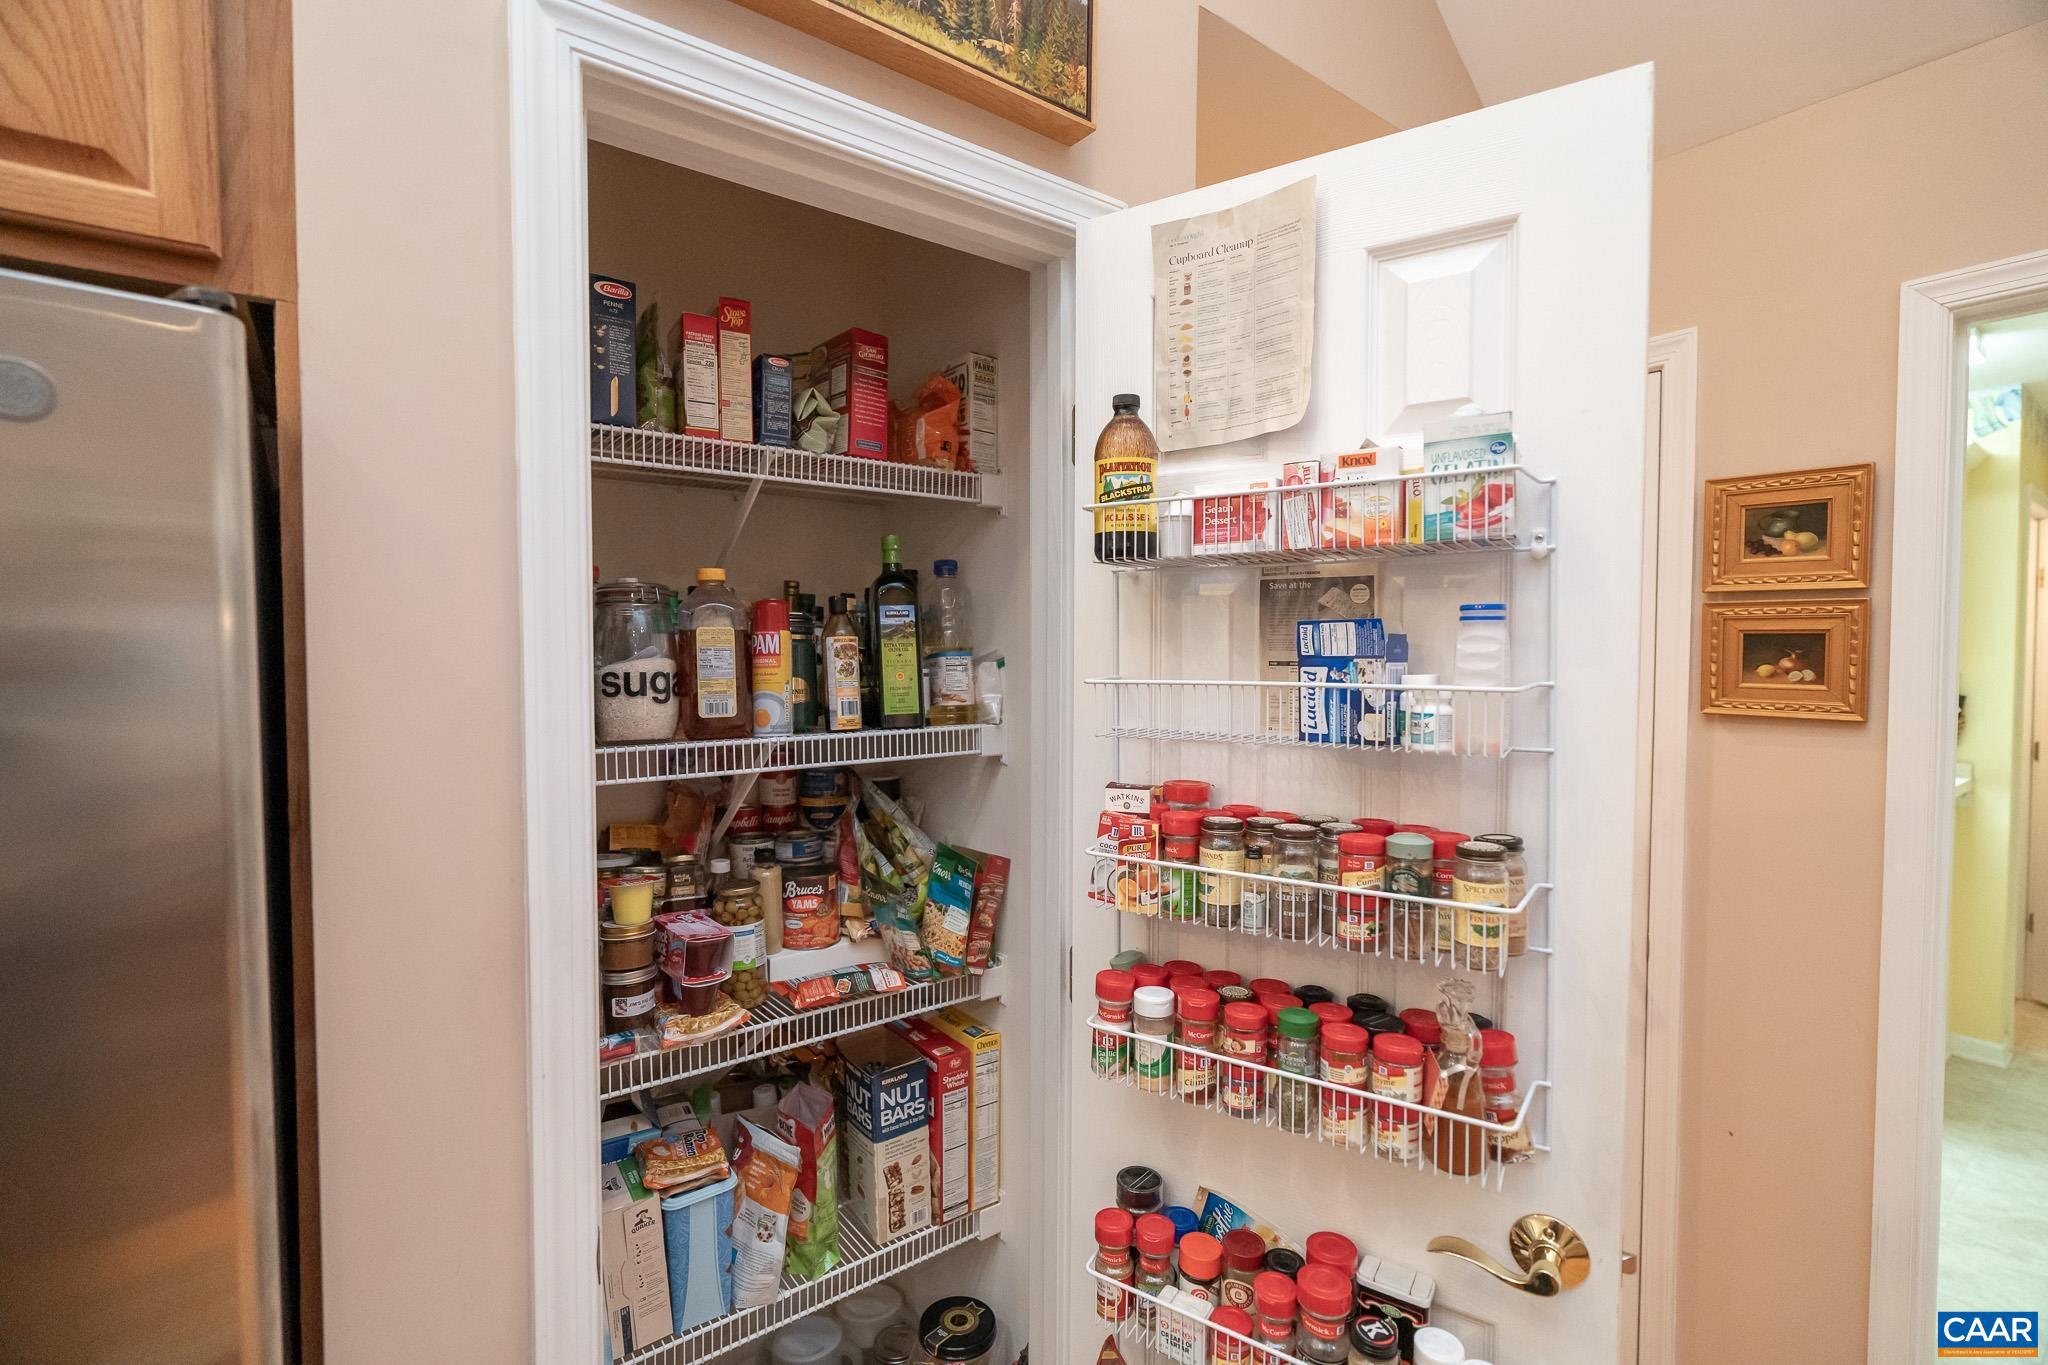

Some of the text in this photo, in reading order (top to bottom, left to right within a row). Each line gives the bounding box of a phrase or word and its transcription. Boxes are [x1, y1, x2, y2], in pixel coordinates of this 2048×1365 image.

[1168, 247, 1214, 266] Cupboard
[1215, 238, 1254, 256] Cleanup
[602, 284, 631, 298] Barilla
[603, 299, 625, 310] PENNE
[720, 305, 747, 323] Stove
[730, 316, 745, 328] Top
[1341, 454, 1374, 467] Knox
[1431, 447, 1487, 465] UNFLAVORED
[1098, 461, 1152, 484] PLANTATION
[1100, 484, 1152, 503] BLACKSTRAP
[1268, 581, 1312, 590] Save at the
[752, 633, 780, 655] PAM
[1109, 793, 1145, 805] WATKINS
[1099, 842, 1118, 851] COCO
[1126, 844, 1148, 852] PURE
[932, 861, 952, 881] Knorr
[782, 880, 825, 898] Bruce's
[1356, 878, 1381, 887] Cumin
[1463, 883, 1486, 894] SPICE
[791, 898, 818, 909] YAMS
[1097, 1049, 1117, 1057] Galic
[881, 1072, 909, 1086] KIRKLAND
[942, 1070, 969, 1085] Shredded
[946, 1079, 966, 1089] Wheat
[846, 1073, 872, 1111] NUT
[880, 1078, 924, 1110] NUT
[1234, 1094, 1252, 1103] Popy
[846, 1095, 873, 1131] BARS
[880, 1097, 926, 1127] BARS
[694, 1129, 708, 1143] Top
[682, 1132, 698, 1157] Ramen
[631, 1219, 656, 1234] QUAKER
